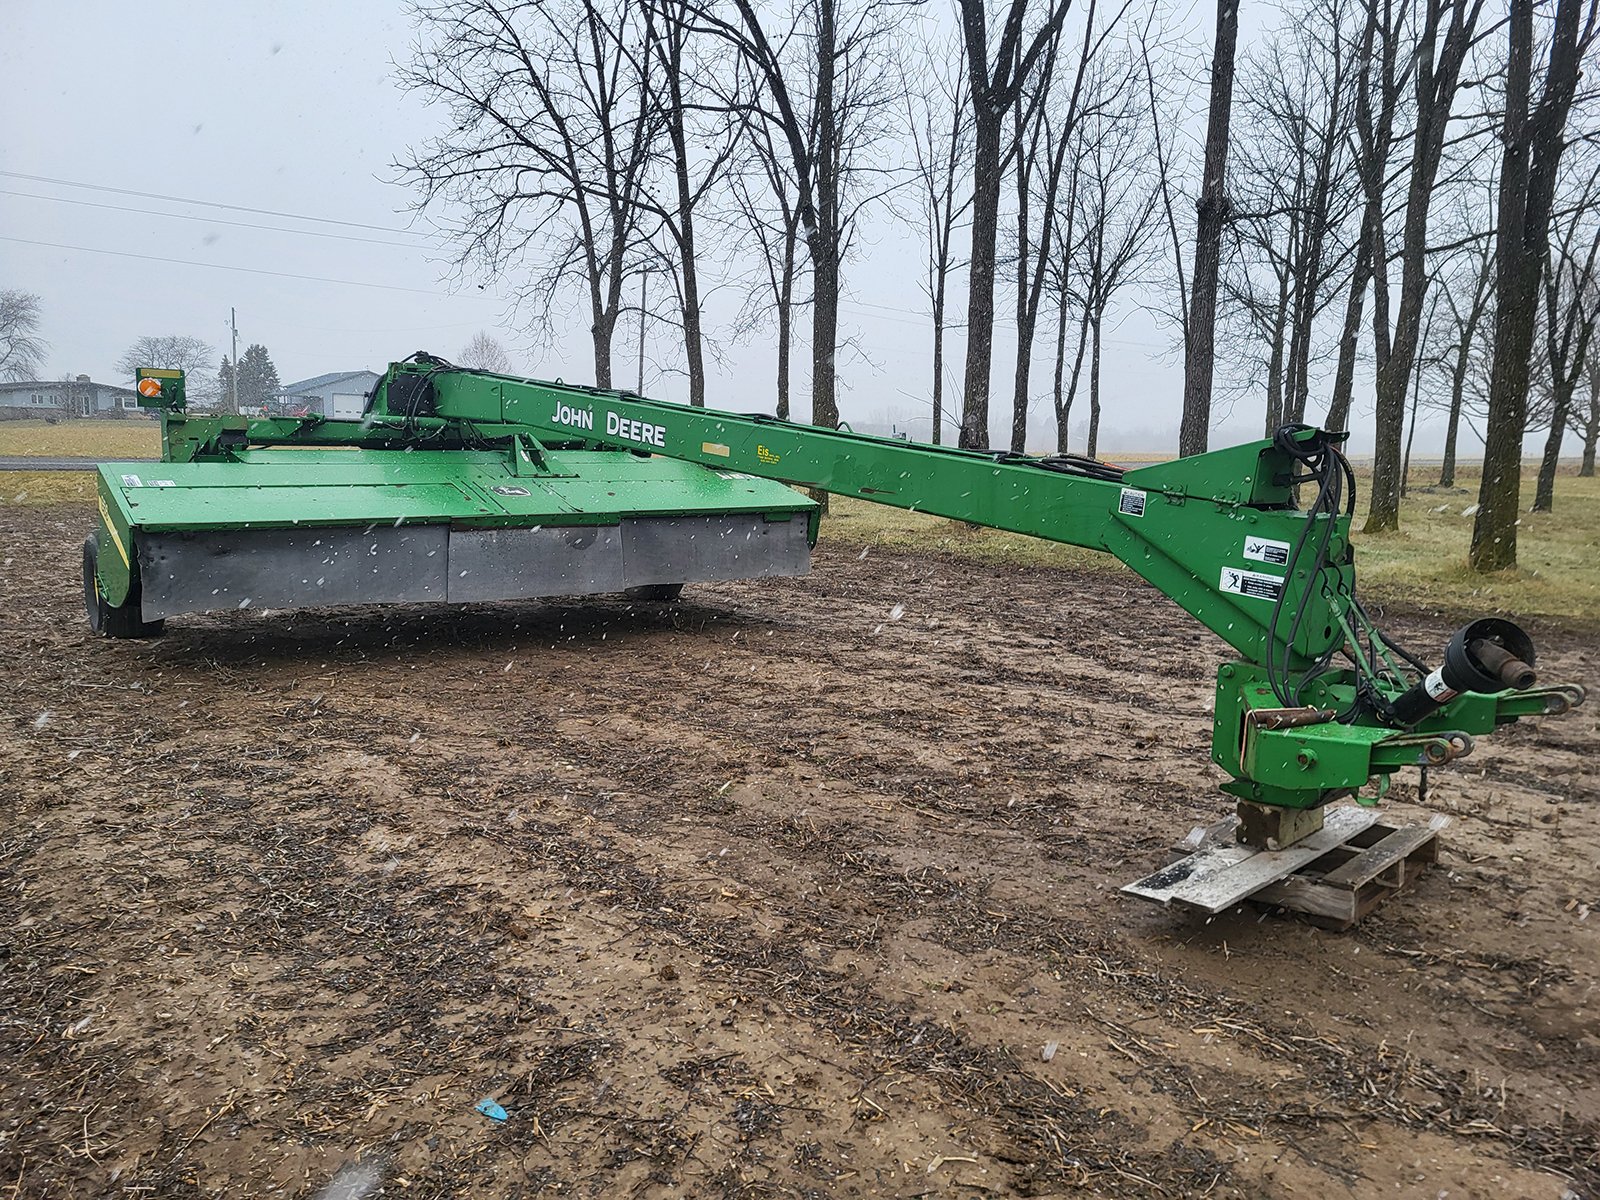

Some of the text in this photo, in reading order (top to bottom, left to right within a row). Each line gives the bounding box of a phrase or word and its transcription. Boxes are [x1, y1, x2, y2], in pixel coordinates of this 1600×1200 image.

[551, 400, 666, 447] JOHN DEERE
[757, 445, 769, 457] Eis
